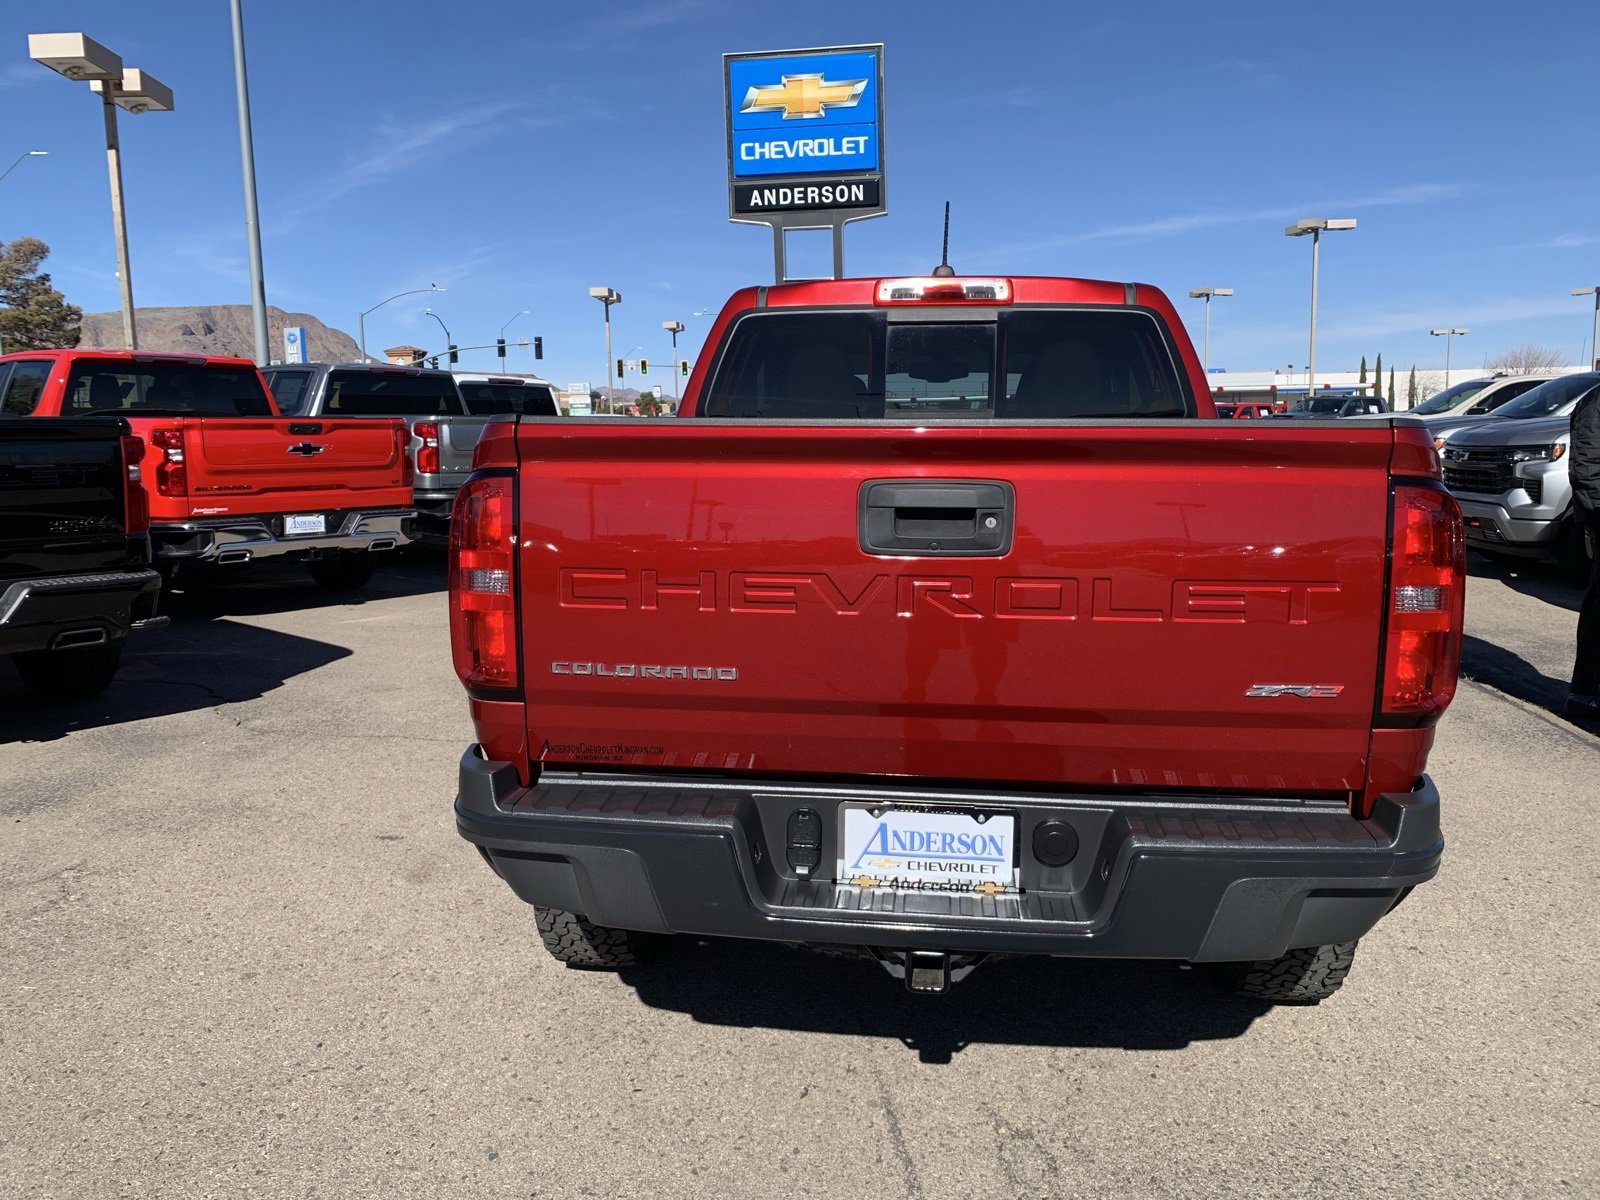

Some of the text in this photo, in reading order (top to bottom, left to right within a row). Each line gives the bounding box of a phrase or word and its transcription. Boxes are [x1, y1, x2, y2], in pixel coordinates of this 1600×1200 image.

[740, 136, 868, 160] CHEVROLET
[750, 184, 864, 206] ANDERSON
[559, 567, 1341, 624] CHEVROLET
[551, 661, 739, 681] COLORADO
[850, 822, 1005, 868] ANDERSON
[907, 860, 999, 875] CHEVROLET
[889, 876, 970, 893] Anderson
